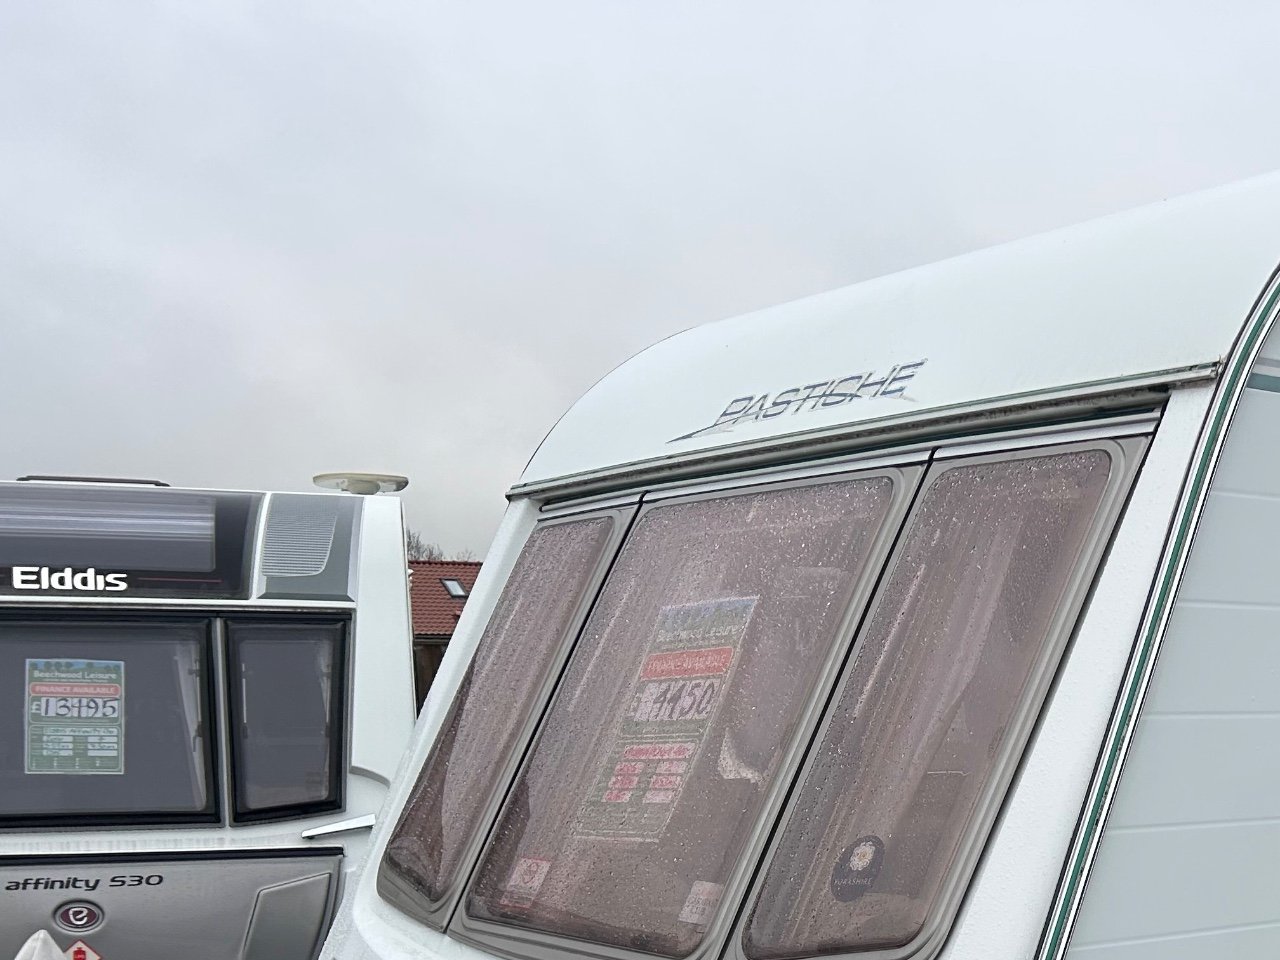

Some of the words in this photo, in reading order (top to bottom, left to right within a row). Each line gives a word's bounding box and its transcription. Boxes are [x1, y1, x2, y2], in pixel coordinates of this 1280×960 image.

[714, 359, 926, 426] PASTICHE
[13, 566, 128, 591] Elddis
[33, 670, 82, 678] Beechwood
[84, 671, 117, 679] Leisure
[5, 877, 101, 891] affinity
